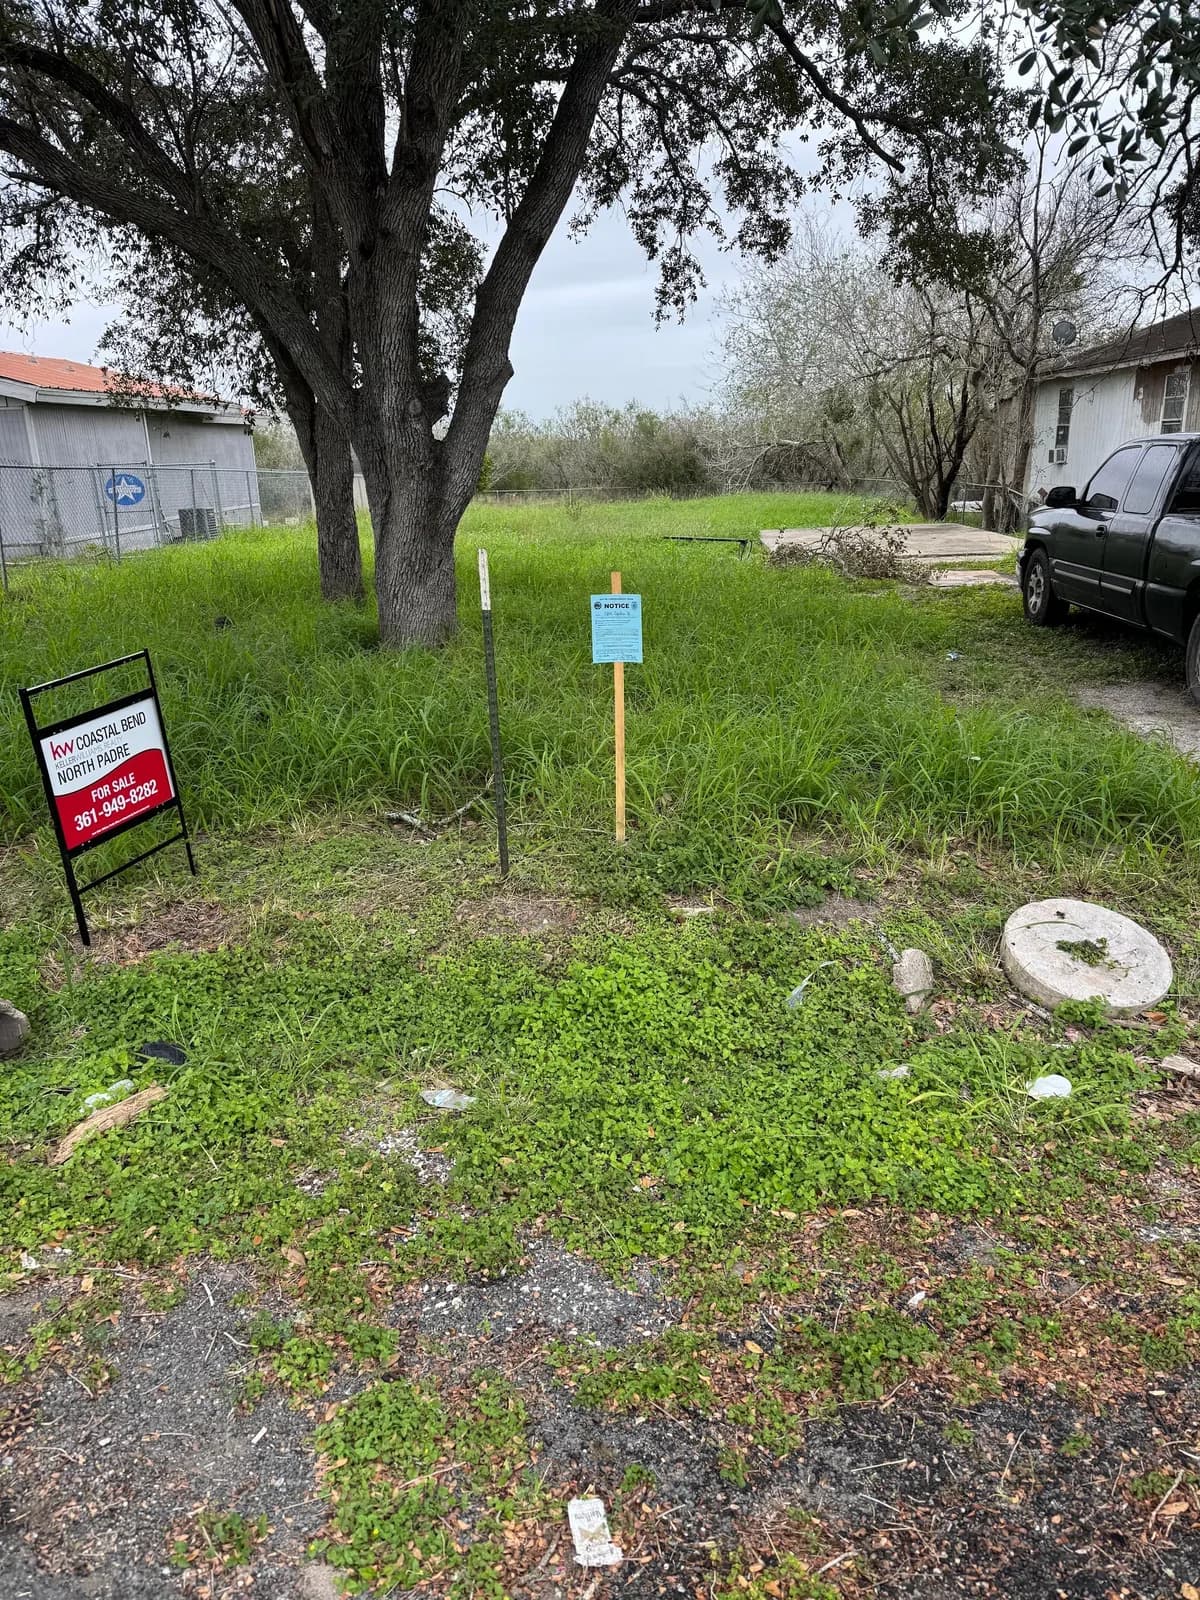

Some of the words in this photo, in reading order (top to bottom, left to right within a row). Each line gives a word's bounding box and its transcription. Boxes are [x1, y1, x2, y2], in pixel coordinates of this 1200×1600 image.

[49, 739, 74, 761] kw
[76, 722, 121, 750] COASTAL
[120, 711, 147, 732] BEND
[57, 758, 96, 785] NORTH
[97, 742, 131, 768] PADRE
[74, 779, 159, 831] 361-949-8282
[91, 784, 111, 803] FOR
[111, 772, 137, 792] SALE
